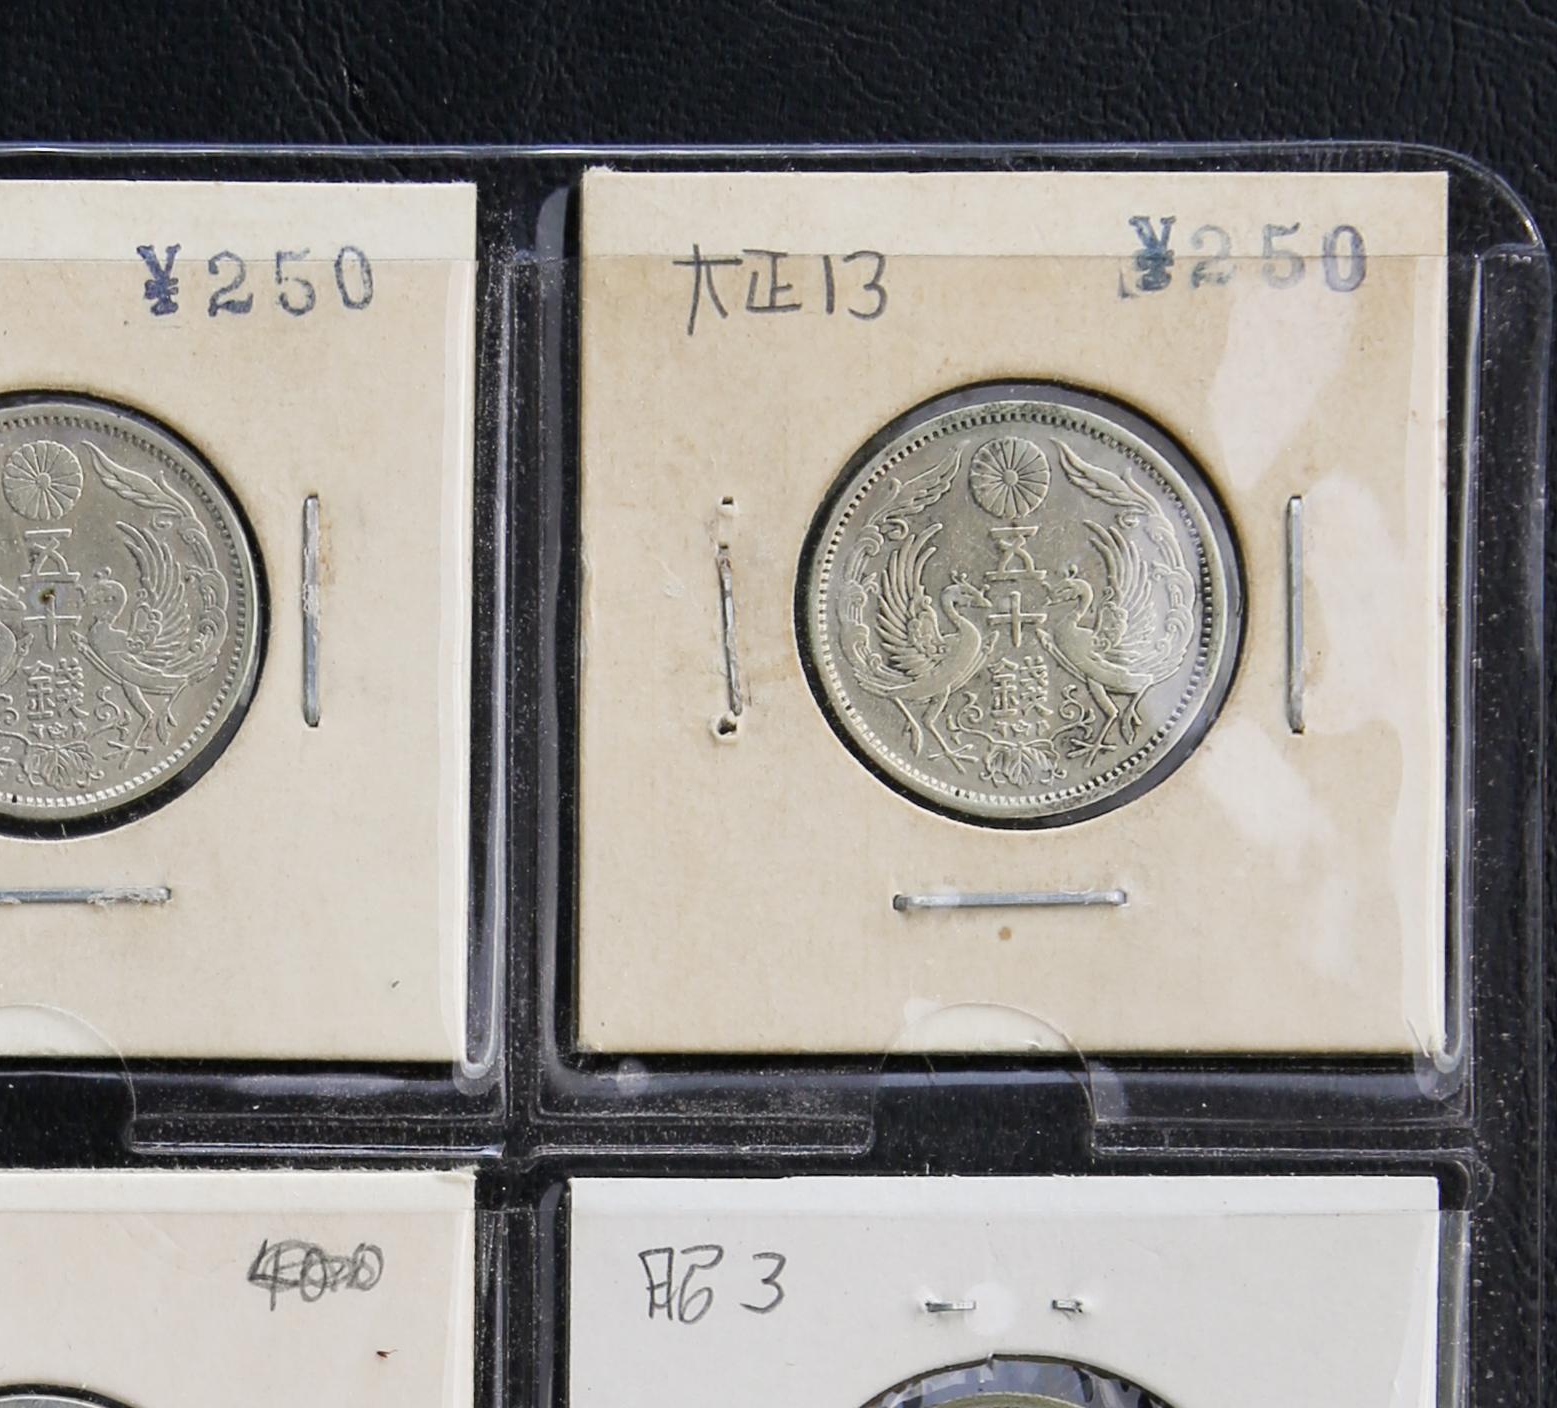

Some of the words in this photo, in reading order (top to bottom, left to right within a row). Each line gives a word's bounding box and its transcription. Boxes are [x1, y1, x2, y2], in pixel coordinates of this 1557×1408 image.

[137, 244, 375, 317] ¥250
[673, 244, 887, 336] 大正13
[1129, 216, 1367, 293] ¥250
